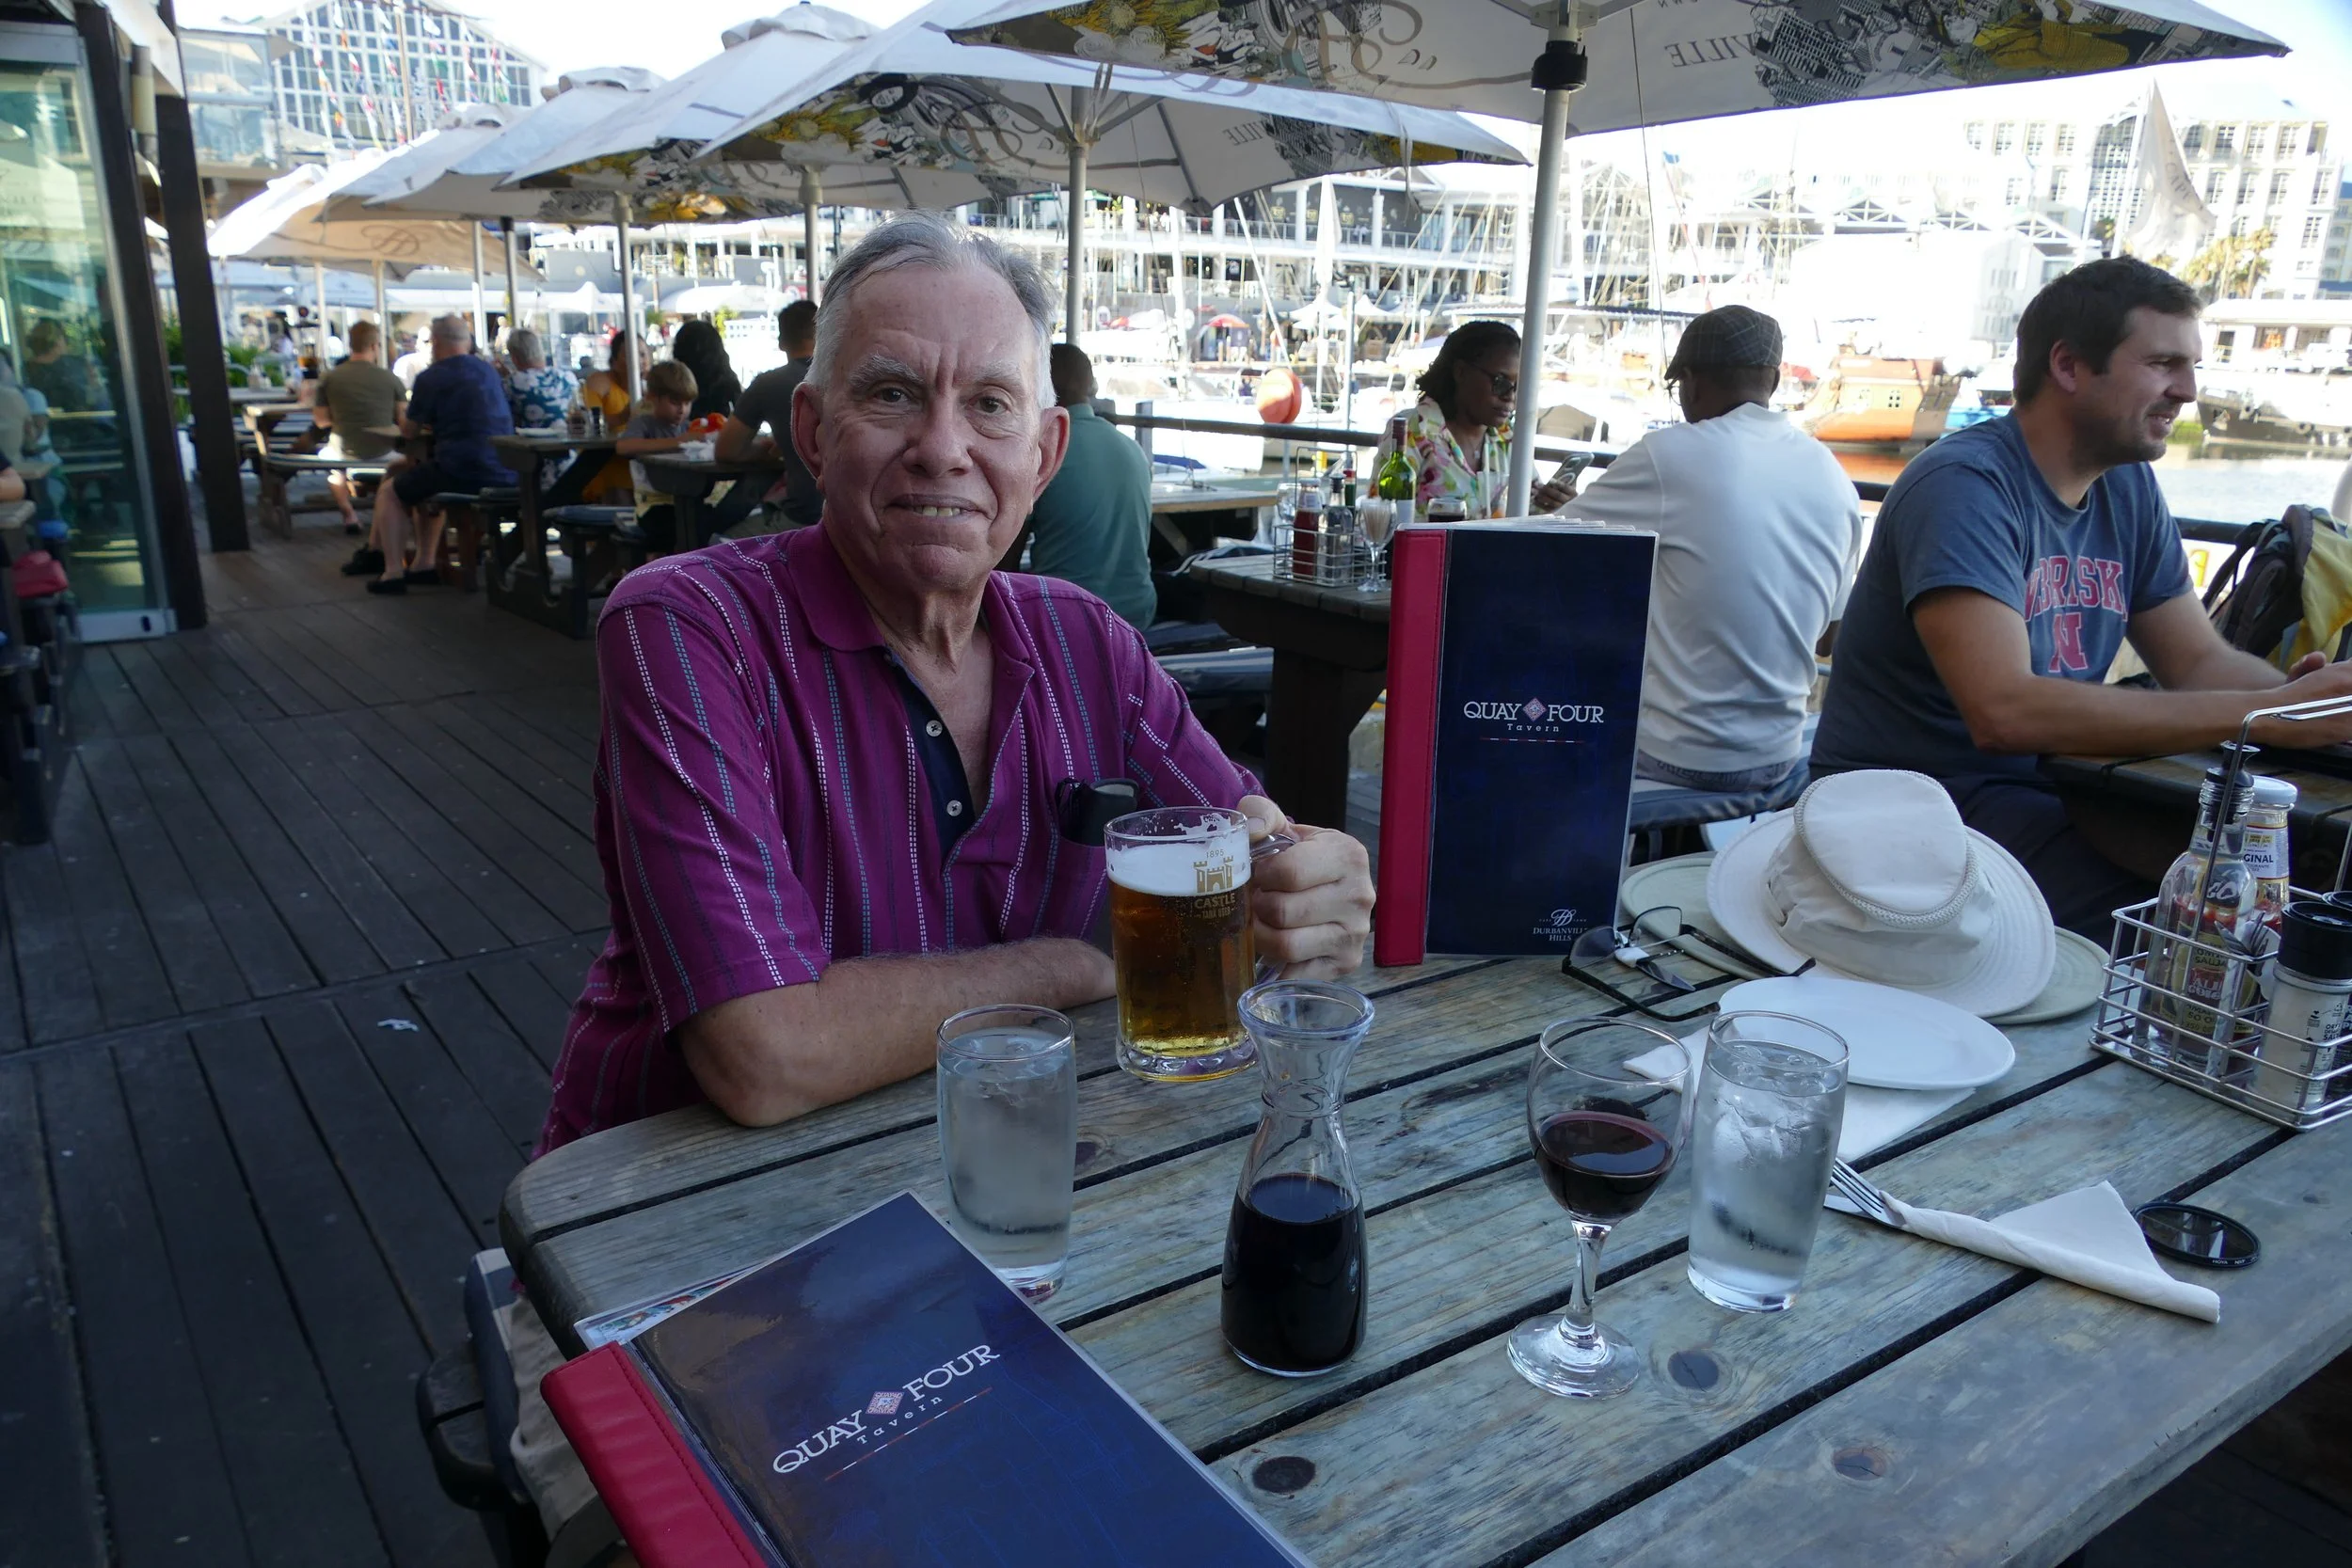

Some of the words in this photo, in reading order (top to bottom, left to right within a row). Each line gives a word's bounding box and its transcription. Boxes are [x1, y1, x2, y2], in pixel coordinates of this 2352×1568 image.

[2048, 611, 2089, 673] N
[1463, 701, 1522, 721] QUAY
[1547, 705, 1604, 723] FOUR
[1506, 723, 1560, 733] Tavern
[1206, 849, 1225, 858] 1895
[2243, 853, 2274, 863] GINAL
[1194, 893, 1236, 910] CASTLE
[1533, 927, 1587, 935] DURBANVILL
[772, 1409, 867, 1474] QUAY
[902, 1344, 1001, 1402] FOUR
[856, 1395, 943, 1445] Tavern
